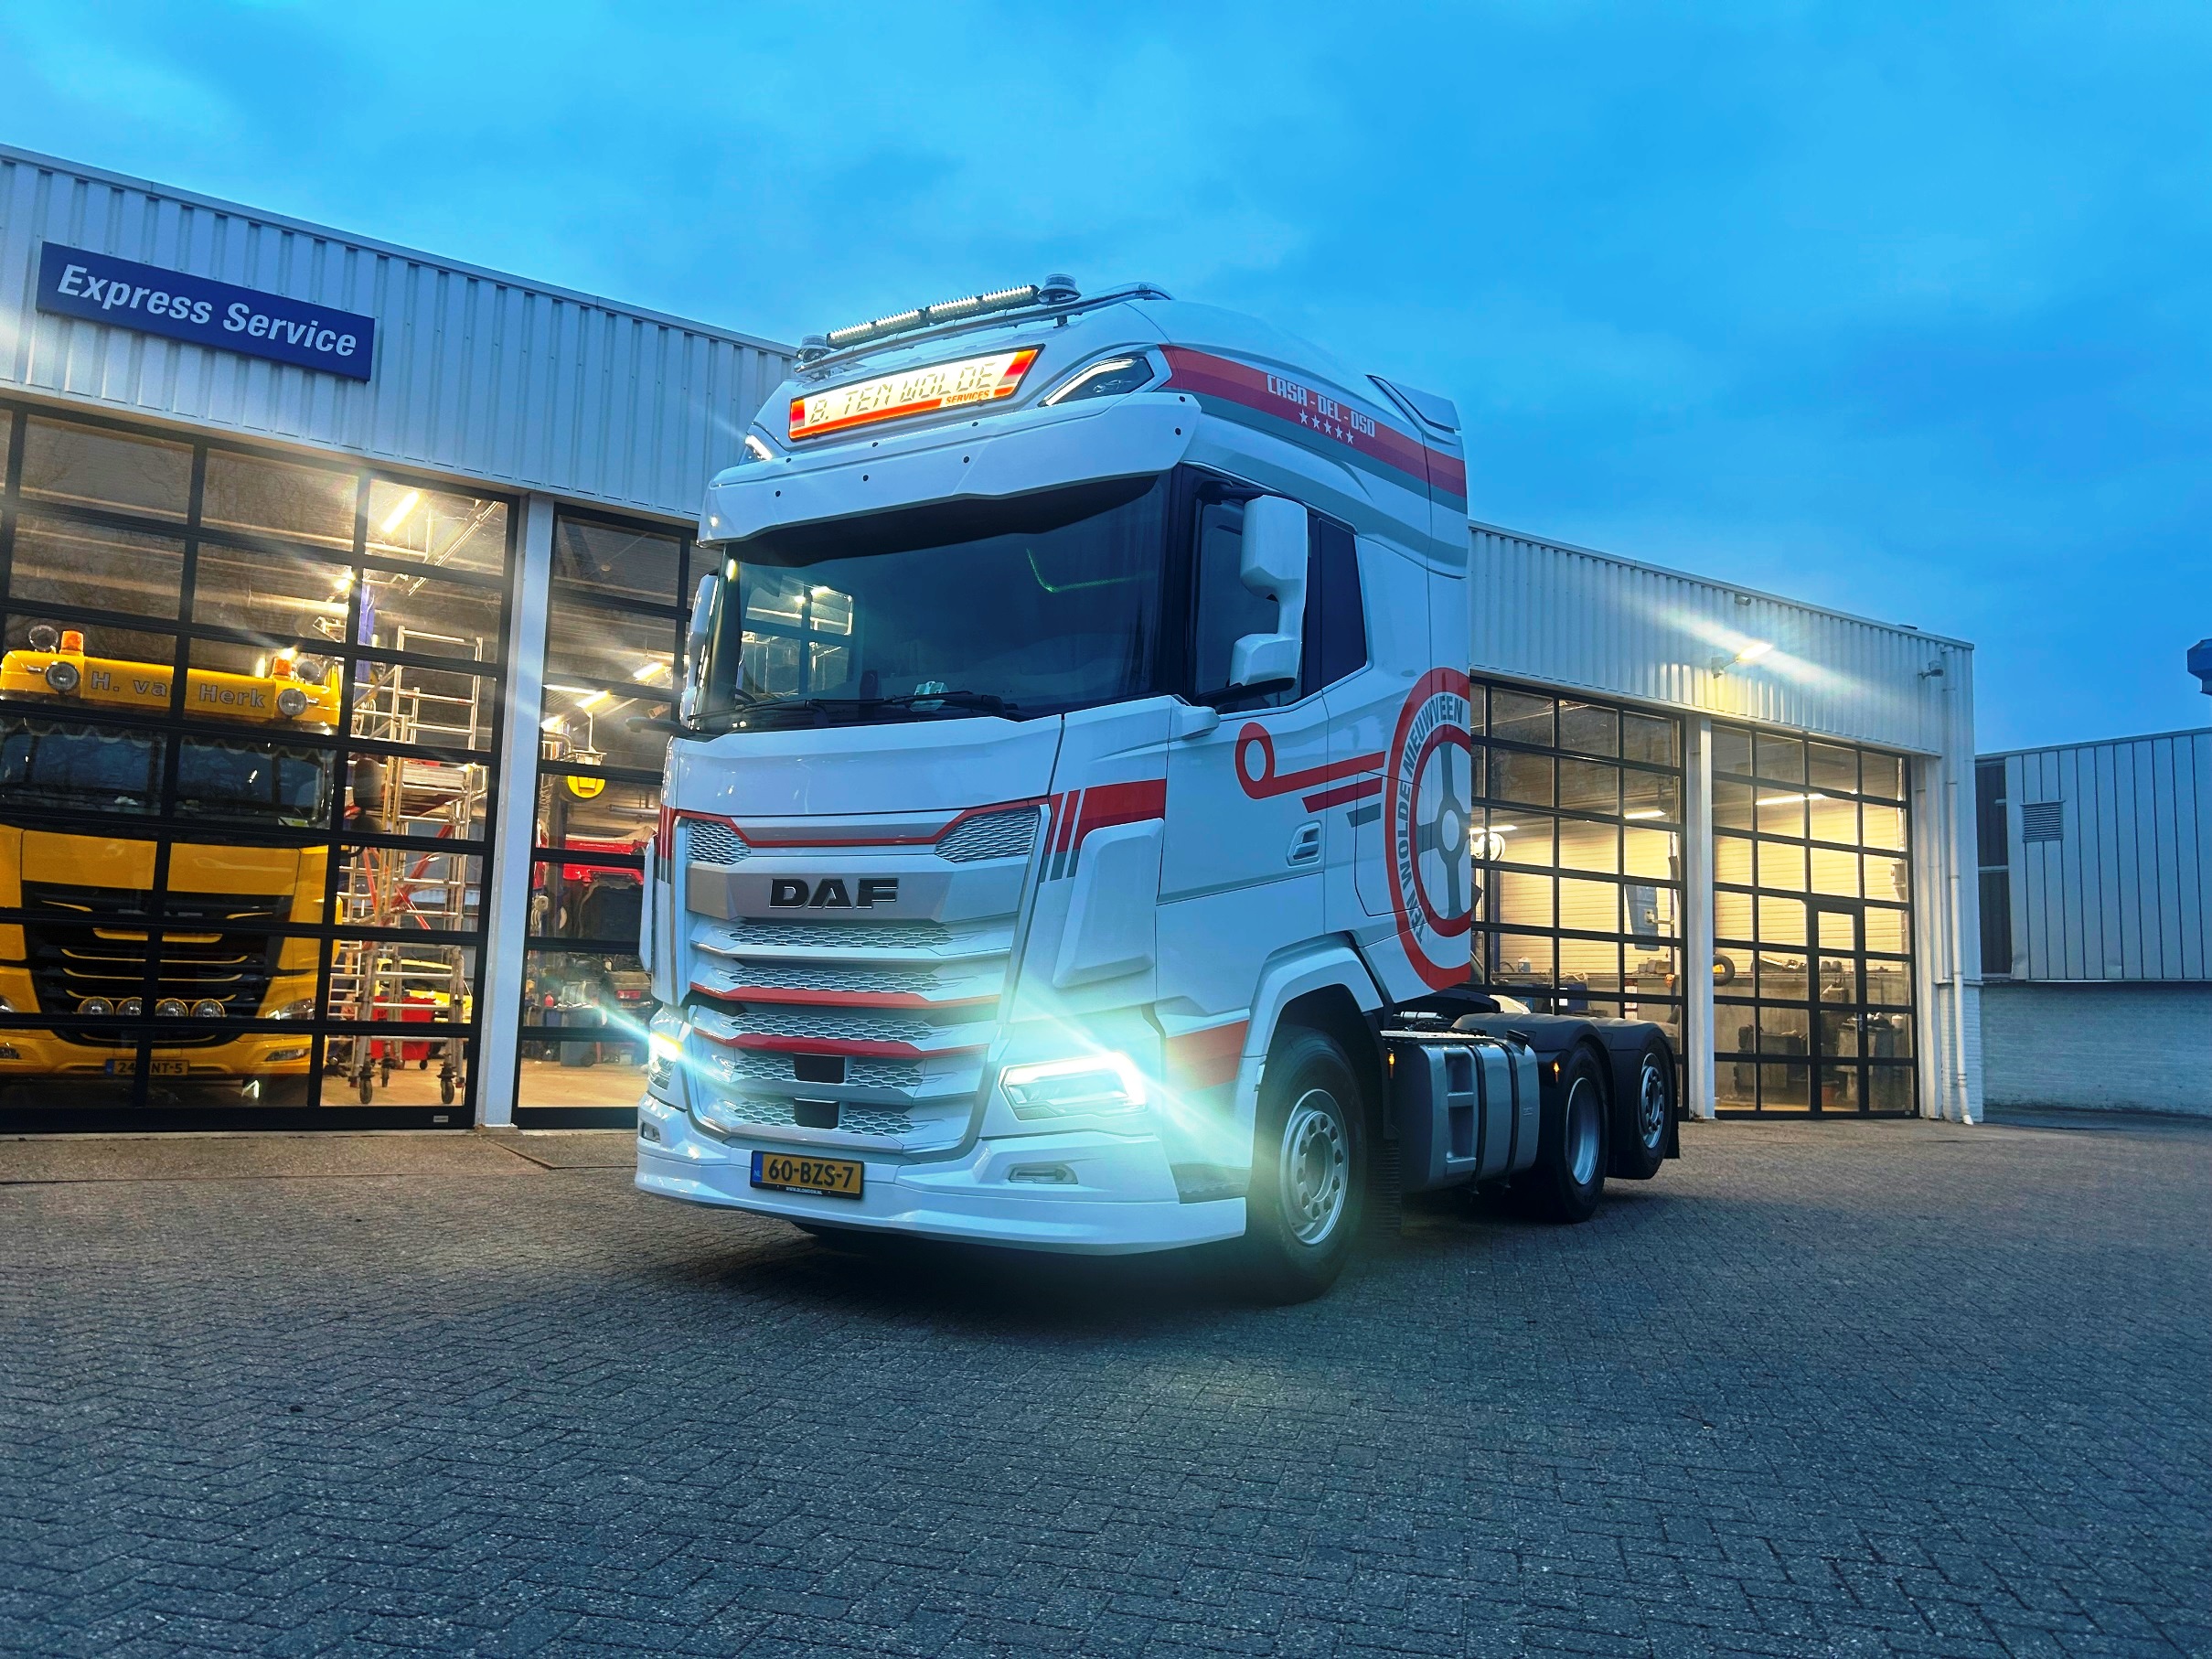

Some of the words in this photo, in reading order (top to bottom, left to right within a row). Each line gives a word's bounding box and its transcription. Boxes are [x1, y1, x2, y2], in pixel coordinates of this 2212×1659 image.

[58, 264, 212, 324] Express
[223, 303, 357, 356] Service
[844, 384, 892, 416] TEN
[945, 390, 989, 405] SERVICES
[91, 671, 120, 691] H.
[133, 680, 167, 697] va
[199, 683, 265, 708] Herk
[1403, 694, 1464, 779] NIEUWVEEN
[1398, 783, 1412, 892] WOLDE
[768, 878, 899, 909] DAF
[768, 1159, 854, 1188] 60-BZS-7
